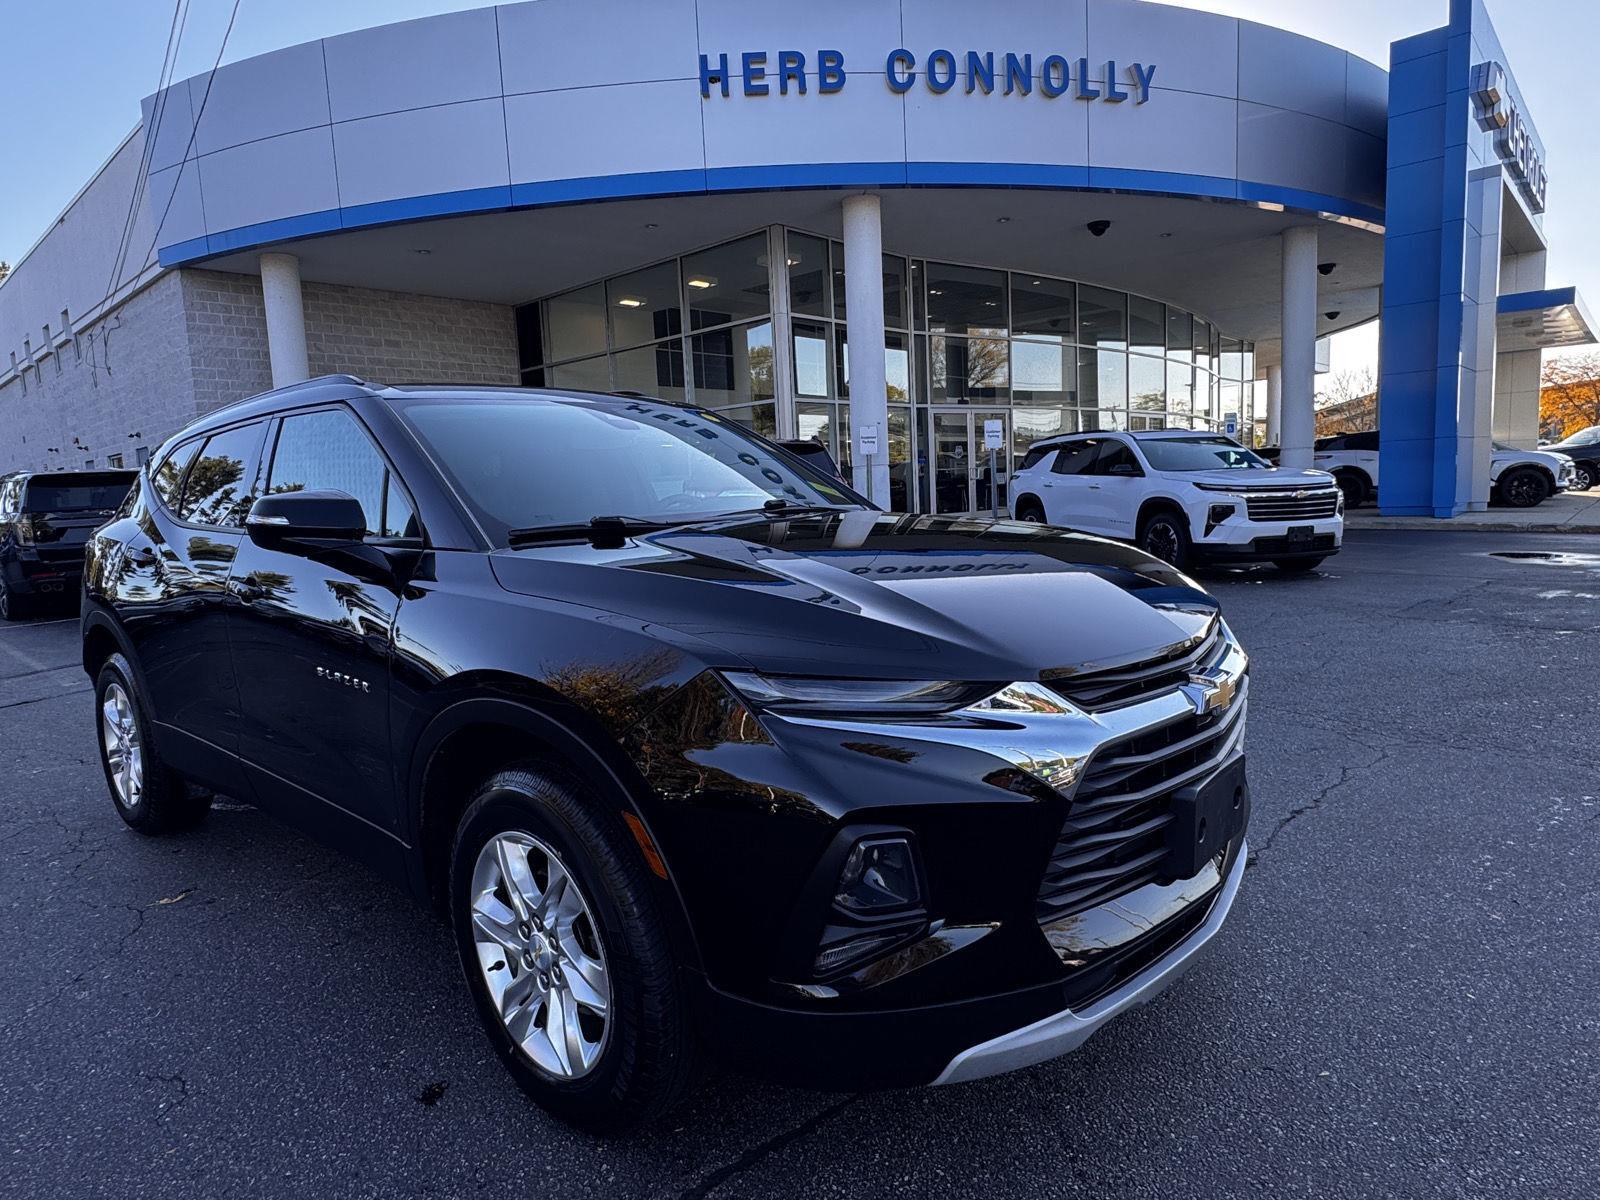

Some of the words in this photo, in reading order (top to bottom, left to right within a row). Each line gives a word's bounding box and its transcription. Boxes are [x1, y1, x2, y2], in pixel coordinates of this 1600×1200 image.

[700, 50, 846, 98] HERB
[885, 48, 1157, 105] CONNOLLY
[316, 666, 369, 693] BLAZER
